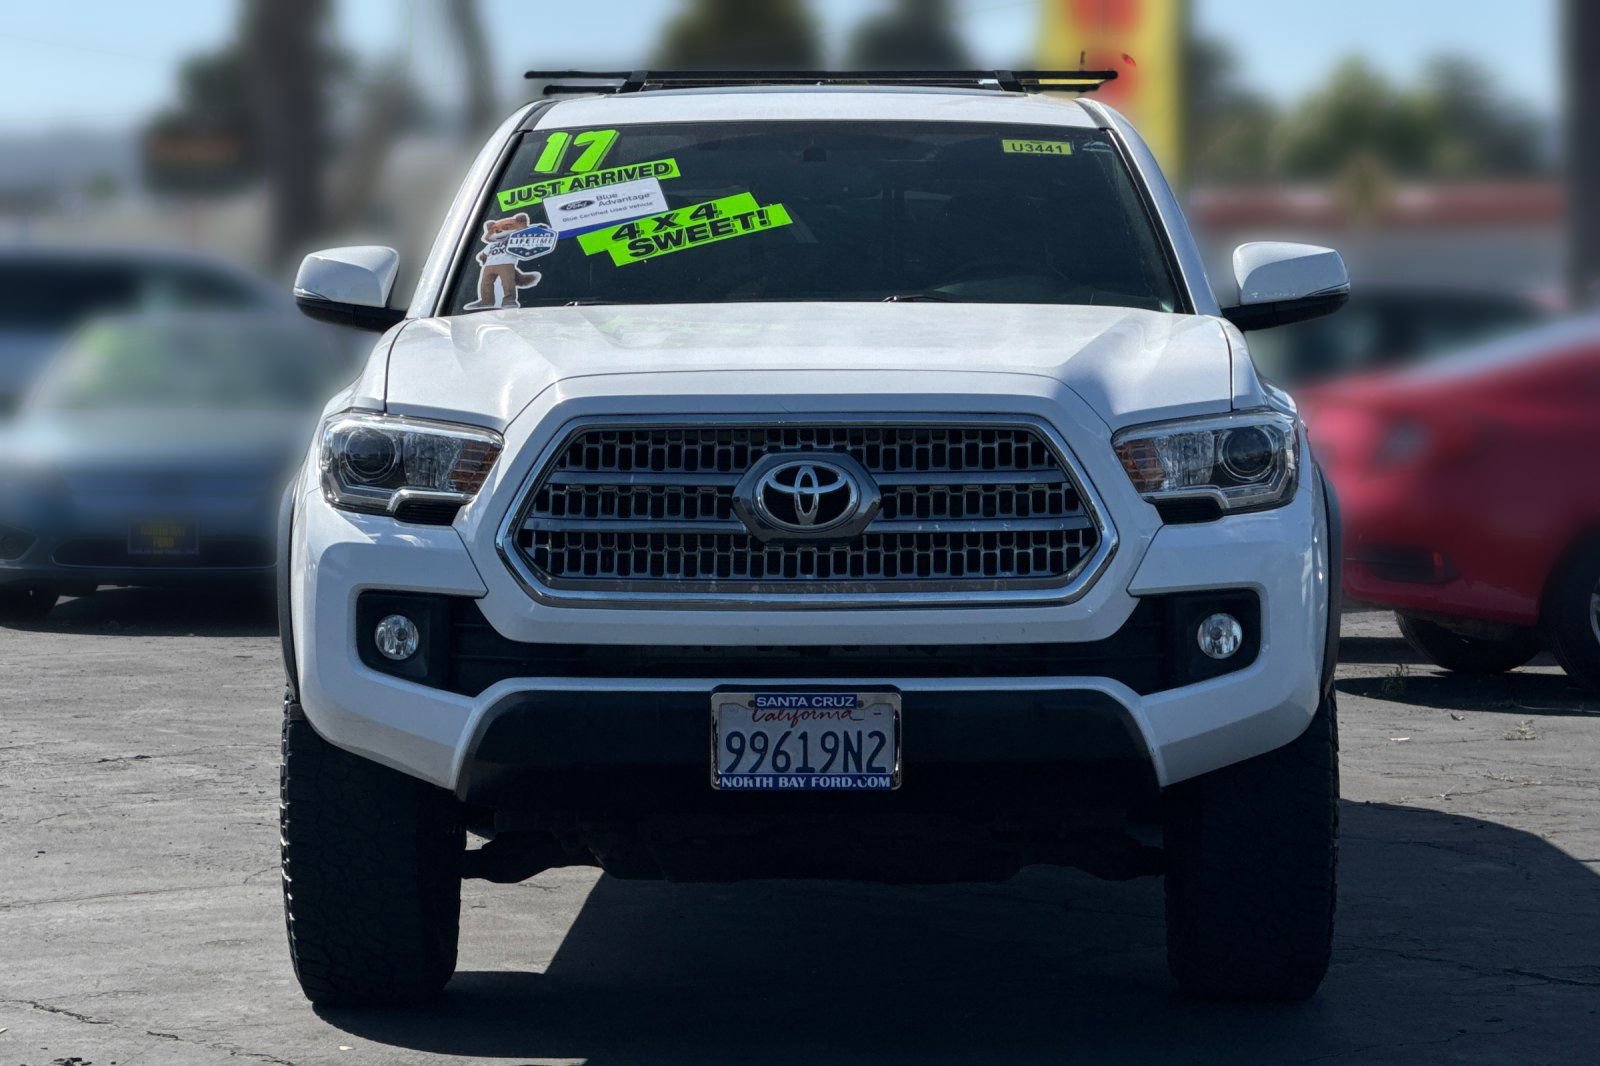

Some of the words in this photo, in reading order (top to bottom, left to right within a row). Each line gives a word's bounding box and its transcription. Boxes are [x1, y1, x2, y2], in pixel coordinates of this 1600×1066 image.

[534, 129, 619, 173] 17
[1011, 143, 1063, 153] U3441
[503, 181, 564, 206] JUST
[568, 161, 673, 191] ARRIVED
[596, 193, 618, 201] Blue
[598, 193, 650, 207] Advantage
[579, 210, 608, 219] Certified
[629, 201, 653, 209] Vehicle
[611, 222, 645, 241] 4
[689, 202, 723, 221] 4
[510, 237, 553, 245] LIFETIME
[628, 209, 771, 258] SWEET!
[756, 696, 809, 707] SANTA
[812, 696, 855, 707] CRUZ
[752, 708, 865, 728] California
[724, 730, 887, 773] 99619N2
[721, 776, 774, 788] NORTH
[778, 776, 806, 788] BAY
[811, 776, 891, 788] FORD.COM
